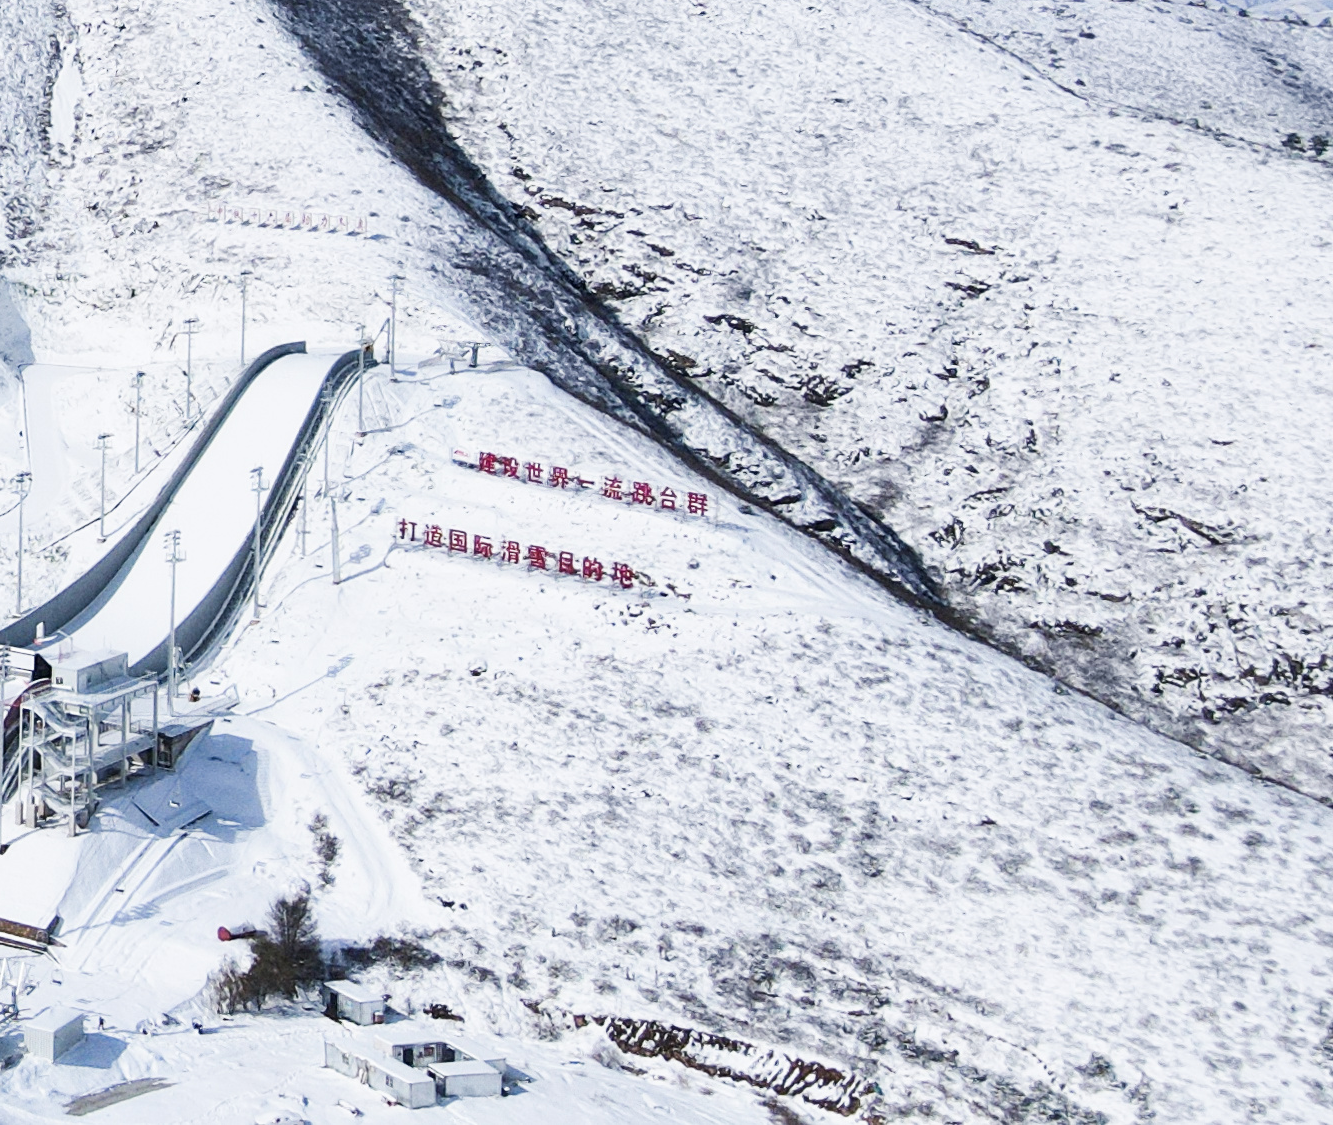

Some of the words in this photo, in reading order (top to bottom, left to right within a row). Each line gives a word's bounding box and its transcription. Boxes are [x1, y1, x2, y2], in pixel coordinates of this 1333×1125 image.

[398, 518, 634, 589] 打造国际滑雪目的地
